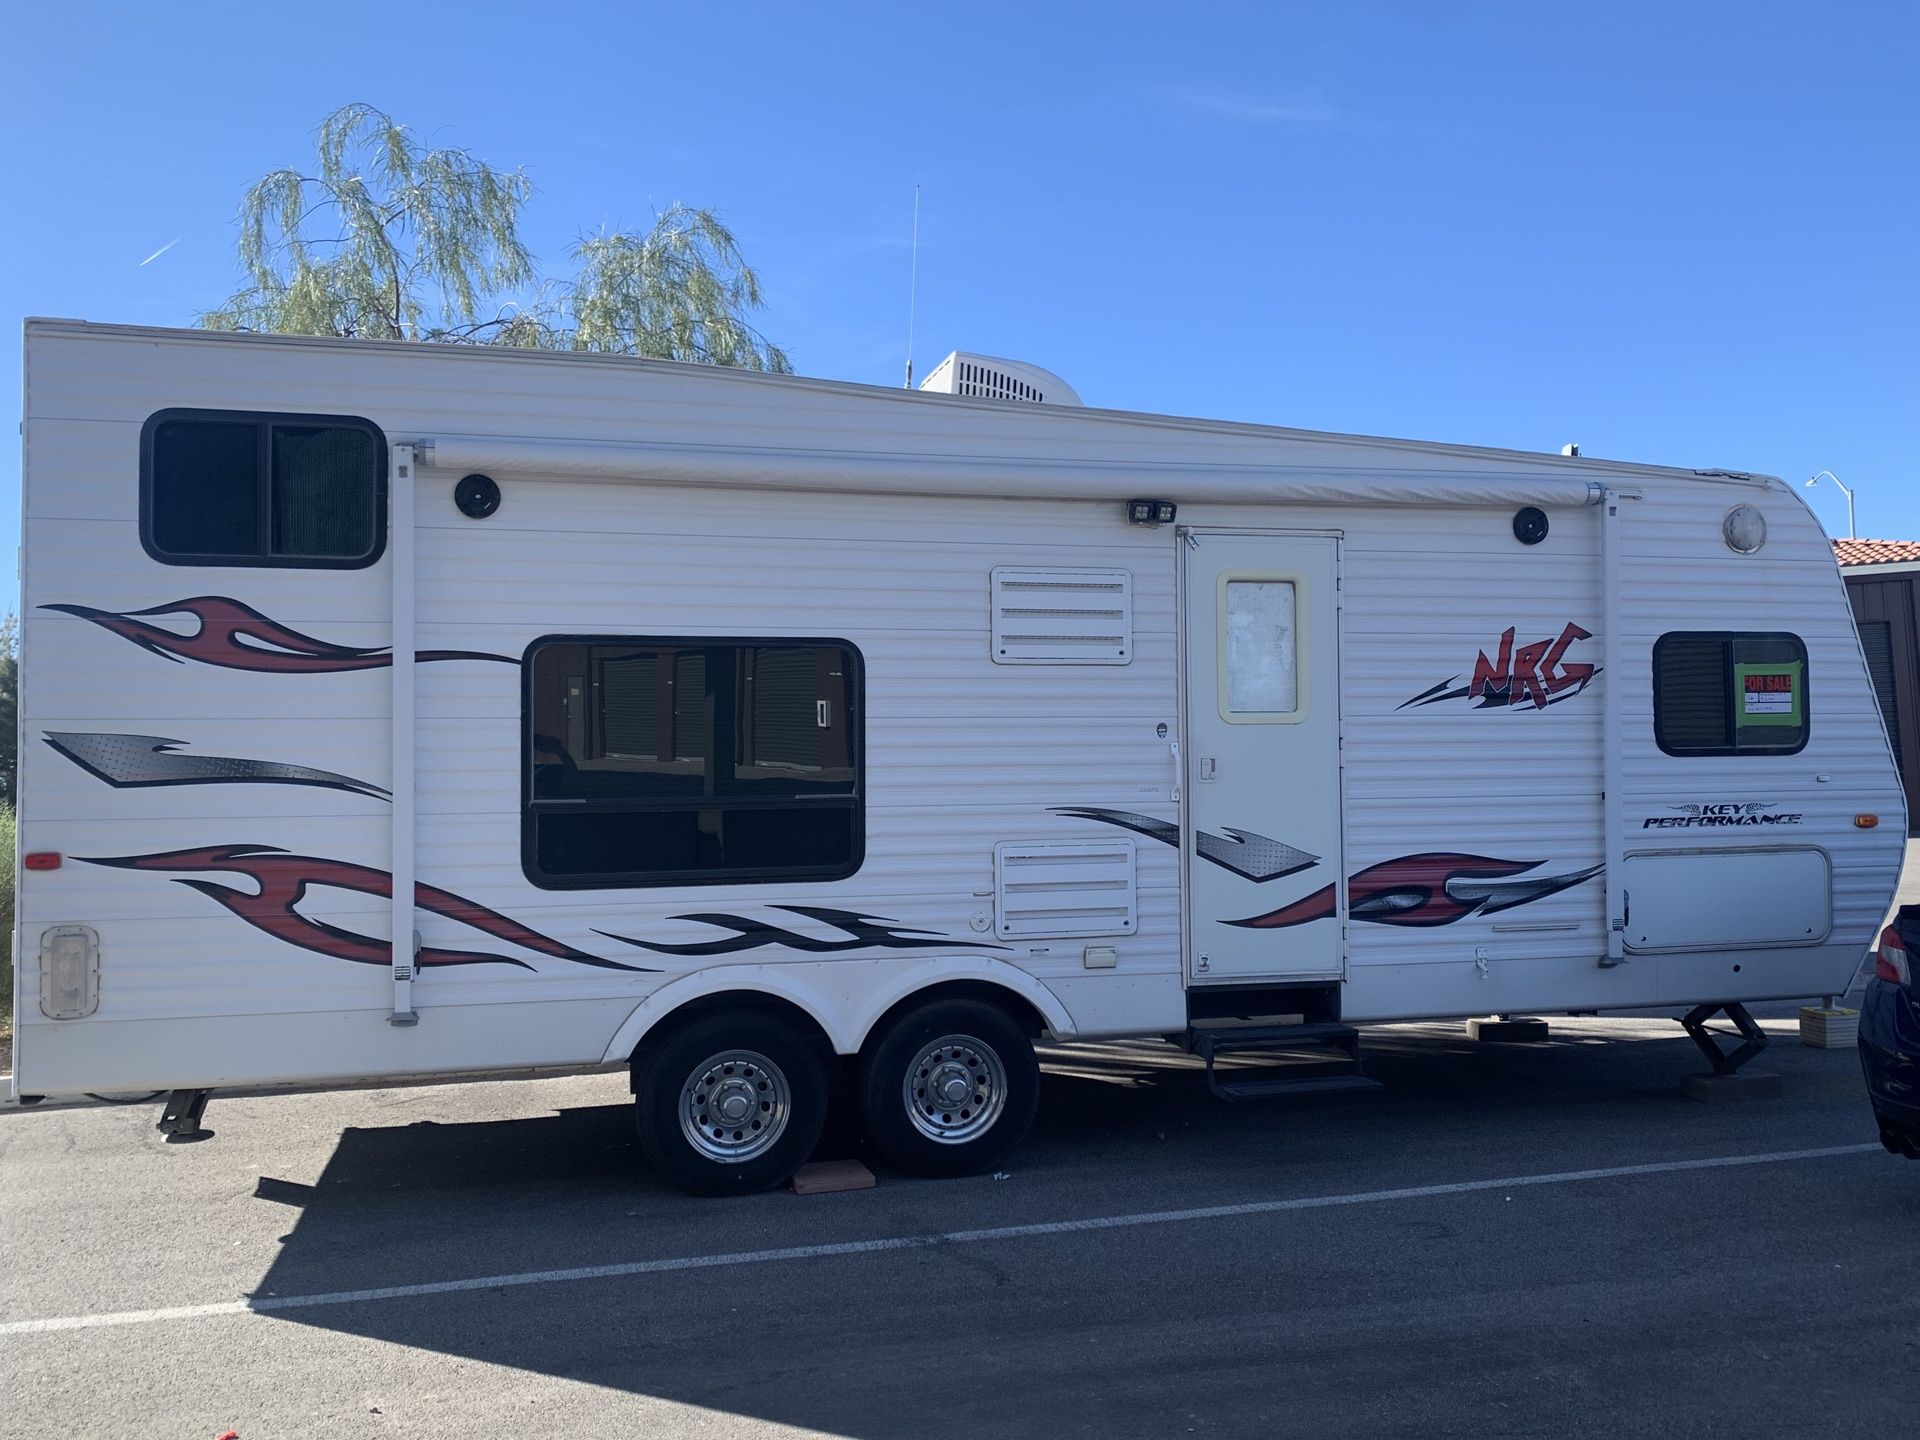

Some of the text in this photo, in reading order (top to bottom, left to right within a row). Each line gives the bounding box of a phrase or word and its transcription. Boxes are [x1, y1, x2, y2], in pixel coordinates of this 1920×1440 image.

[1468, 621, 1595, 711] NRG
[1767, 675, 1792, 692] SALE
[1702, 803, 1747, 816] KEY
[1642, 813, 1803, 829] PERFORMANCE
